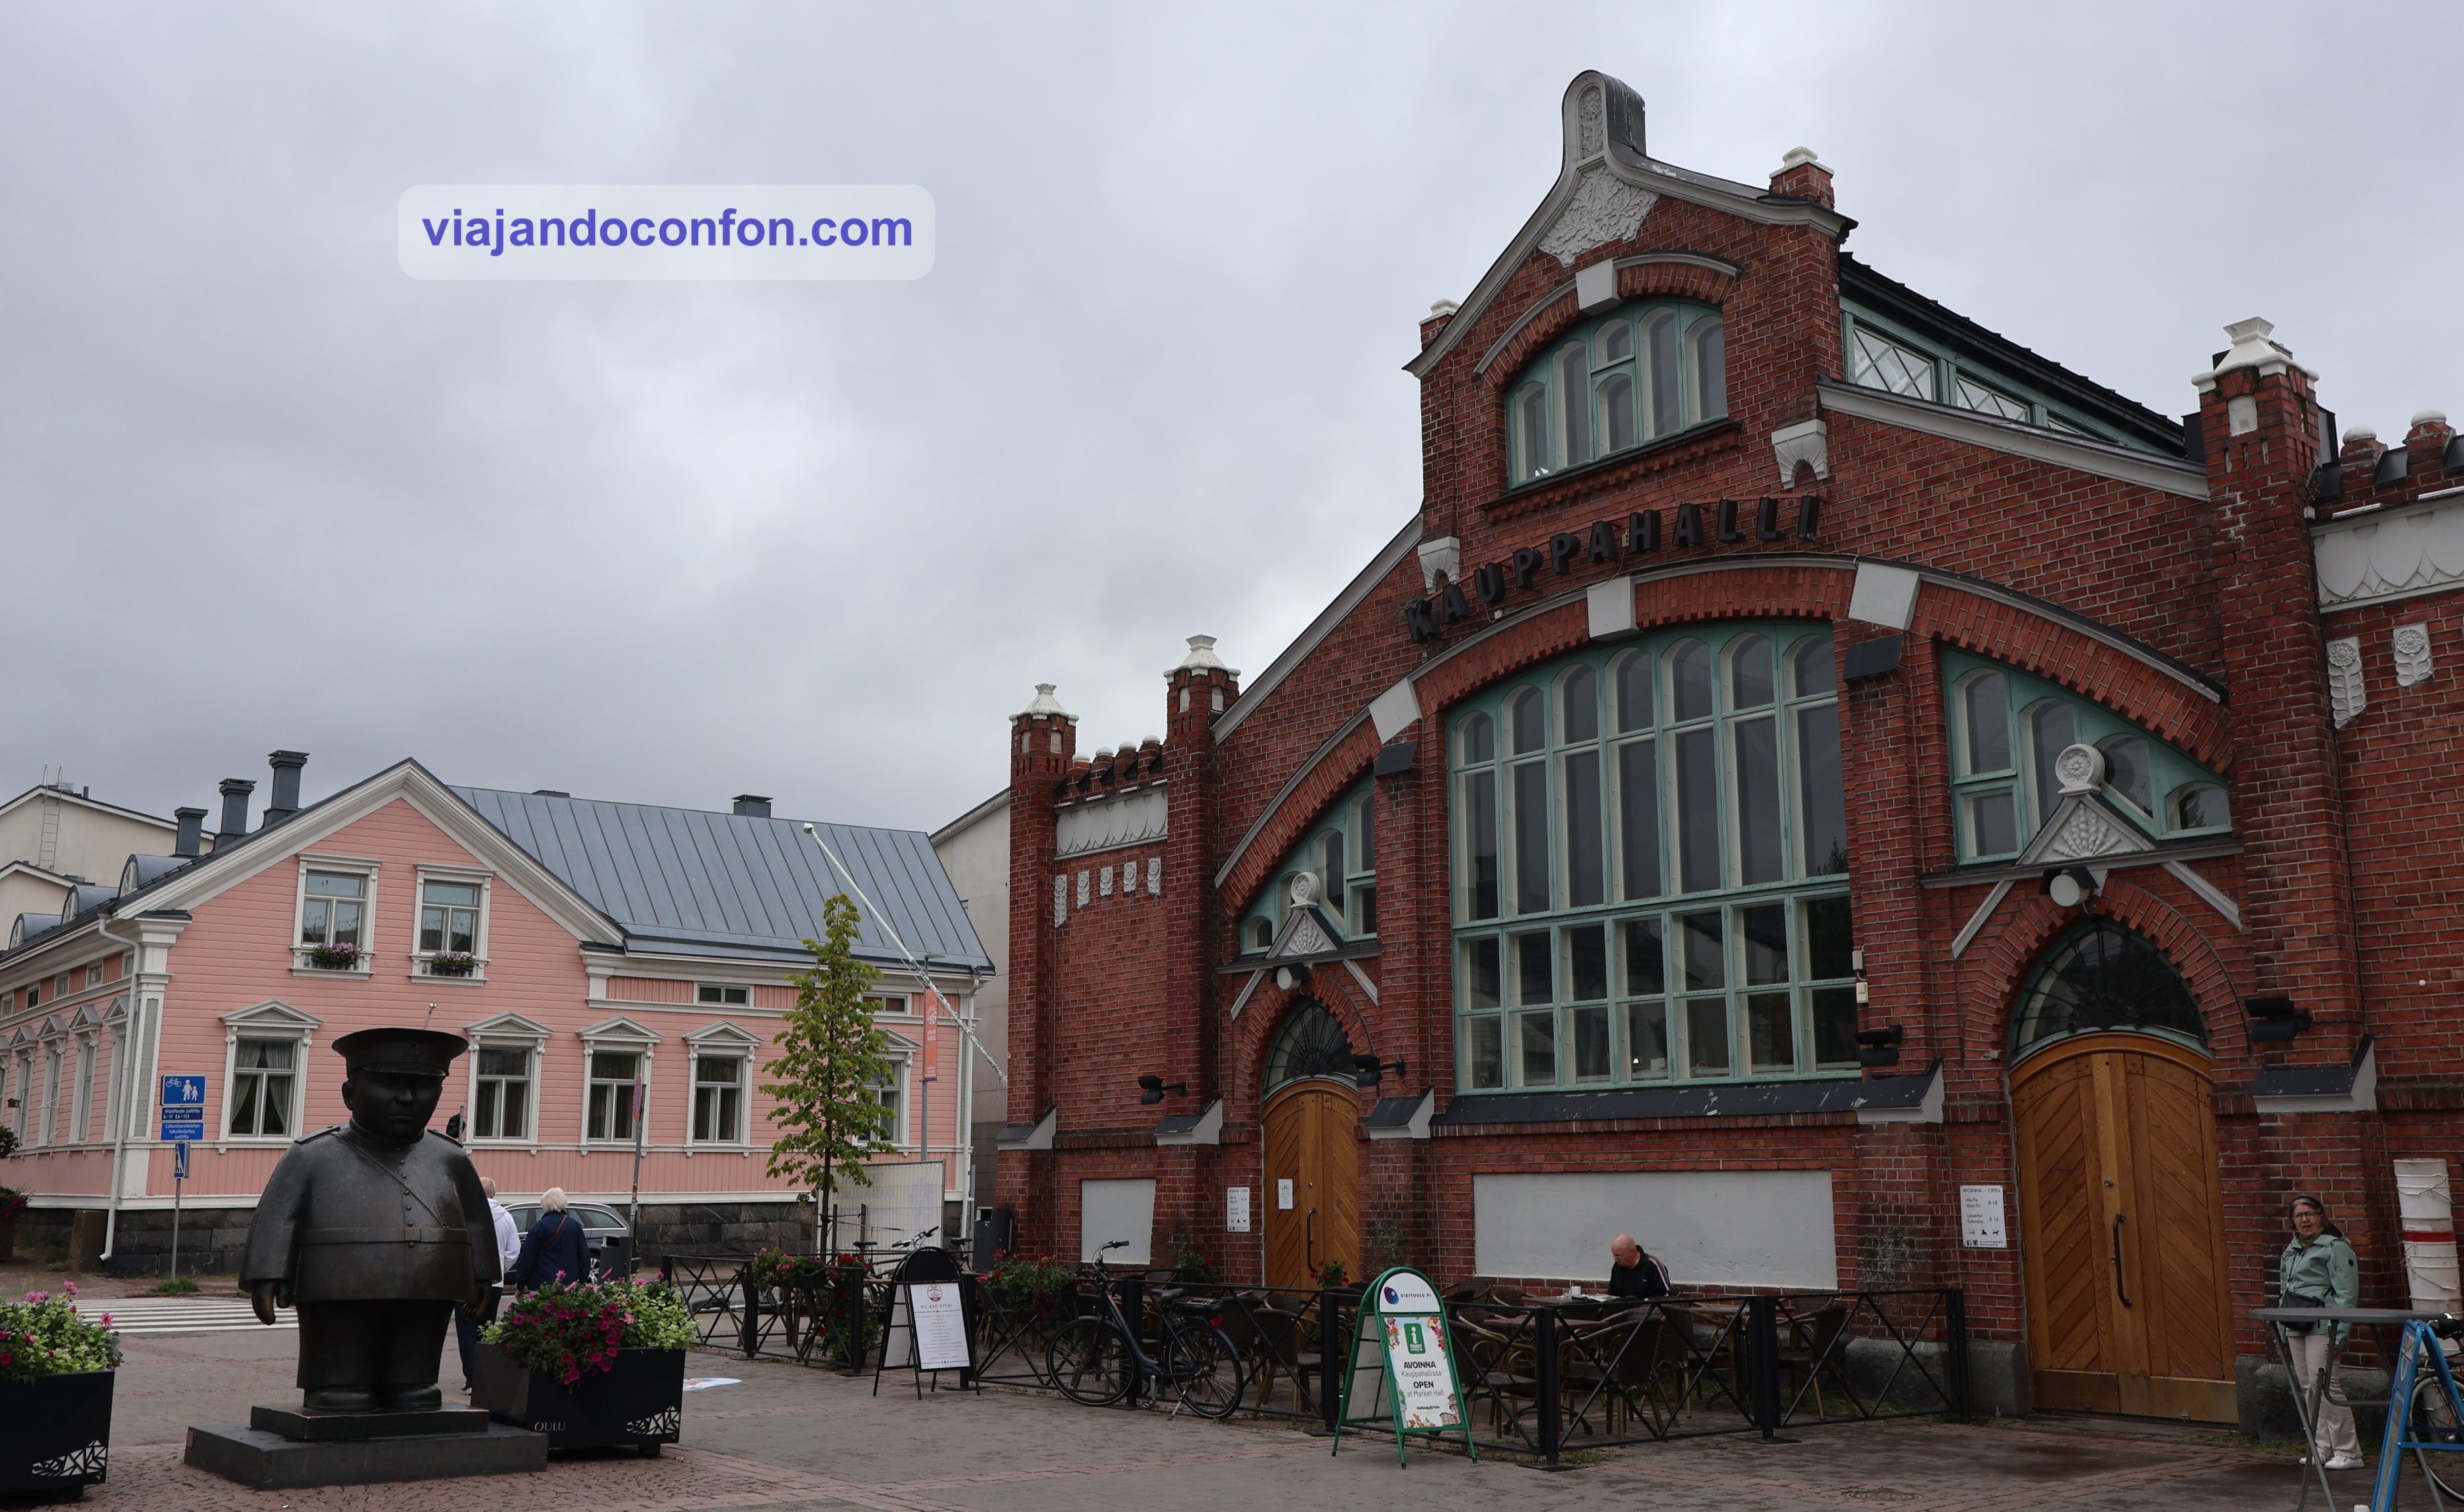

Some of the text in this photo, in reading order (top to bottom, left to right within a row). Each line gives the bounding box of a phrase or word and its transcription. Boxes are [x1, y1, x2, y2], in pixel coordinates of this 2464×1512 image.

[1405, 495, 1820, 644] KAUPPAHALLI
[1404, 1361, 1437, 1369] AVOINNA
[1401, 1370, 1442, 1378] Kauppahallissa
[1413, 1381, 1434, 1389] OPEN
[534, 1421, 566, 1431] OULU
